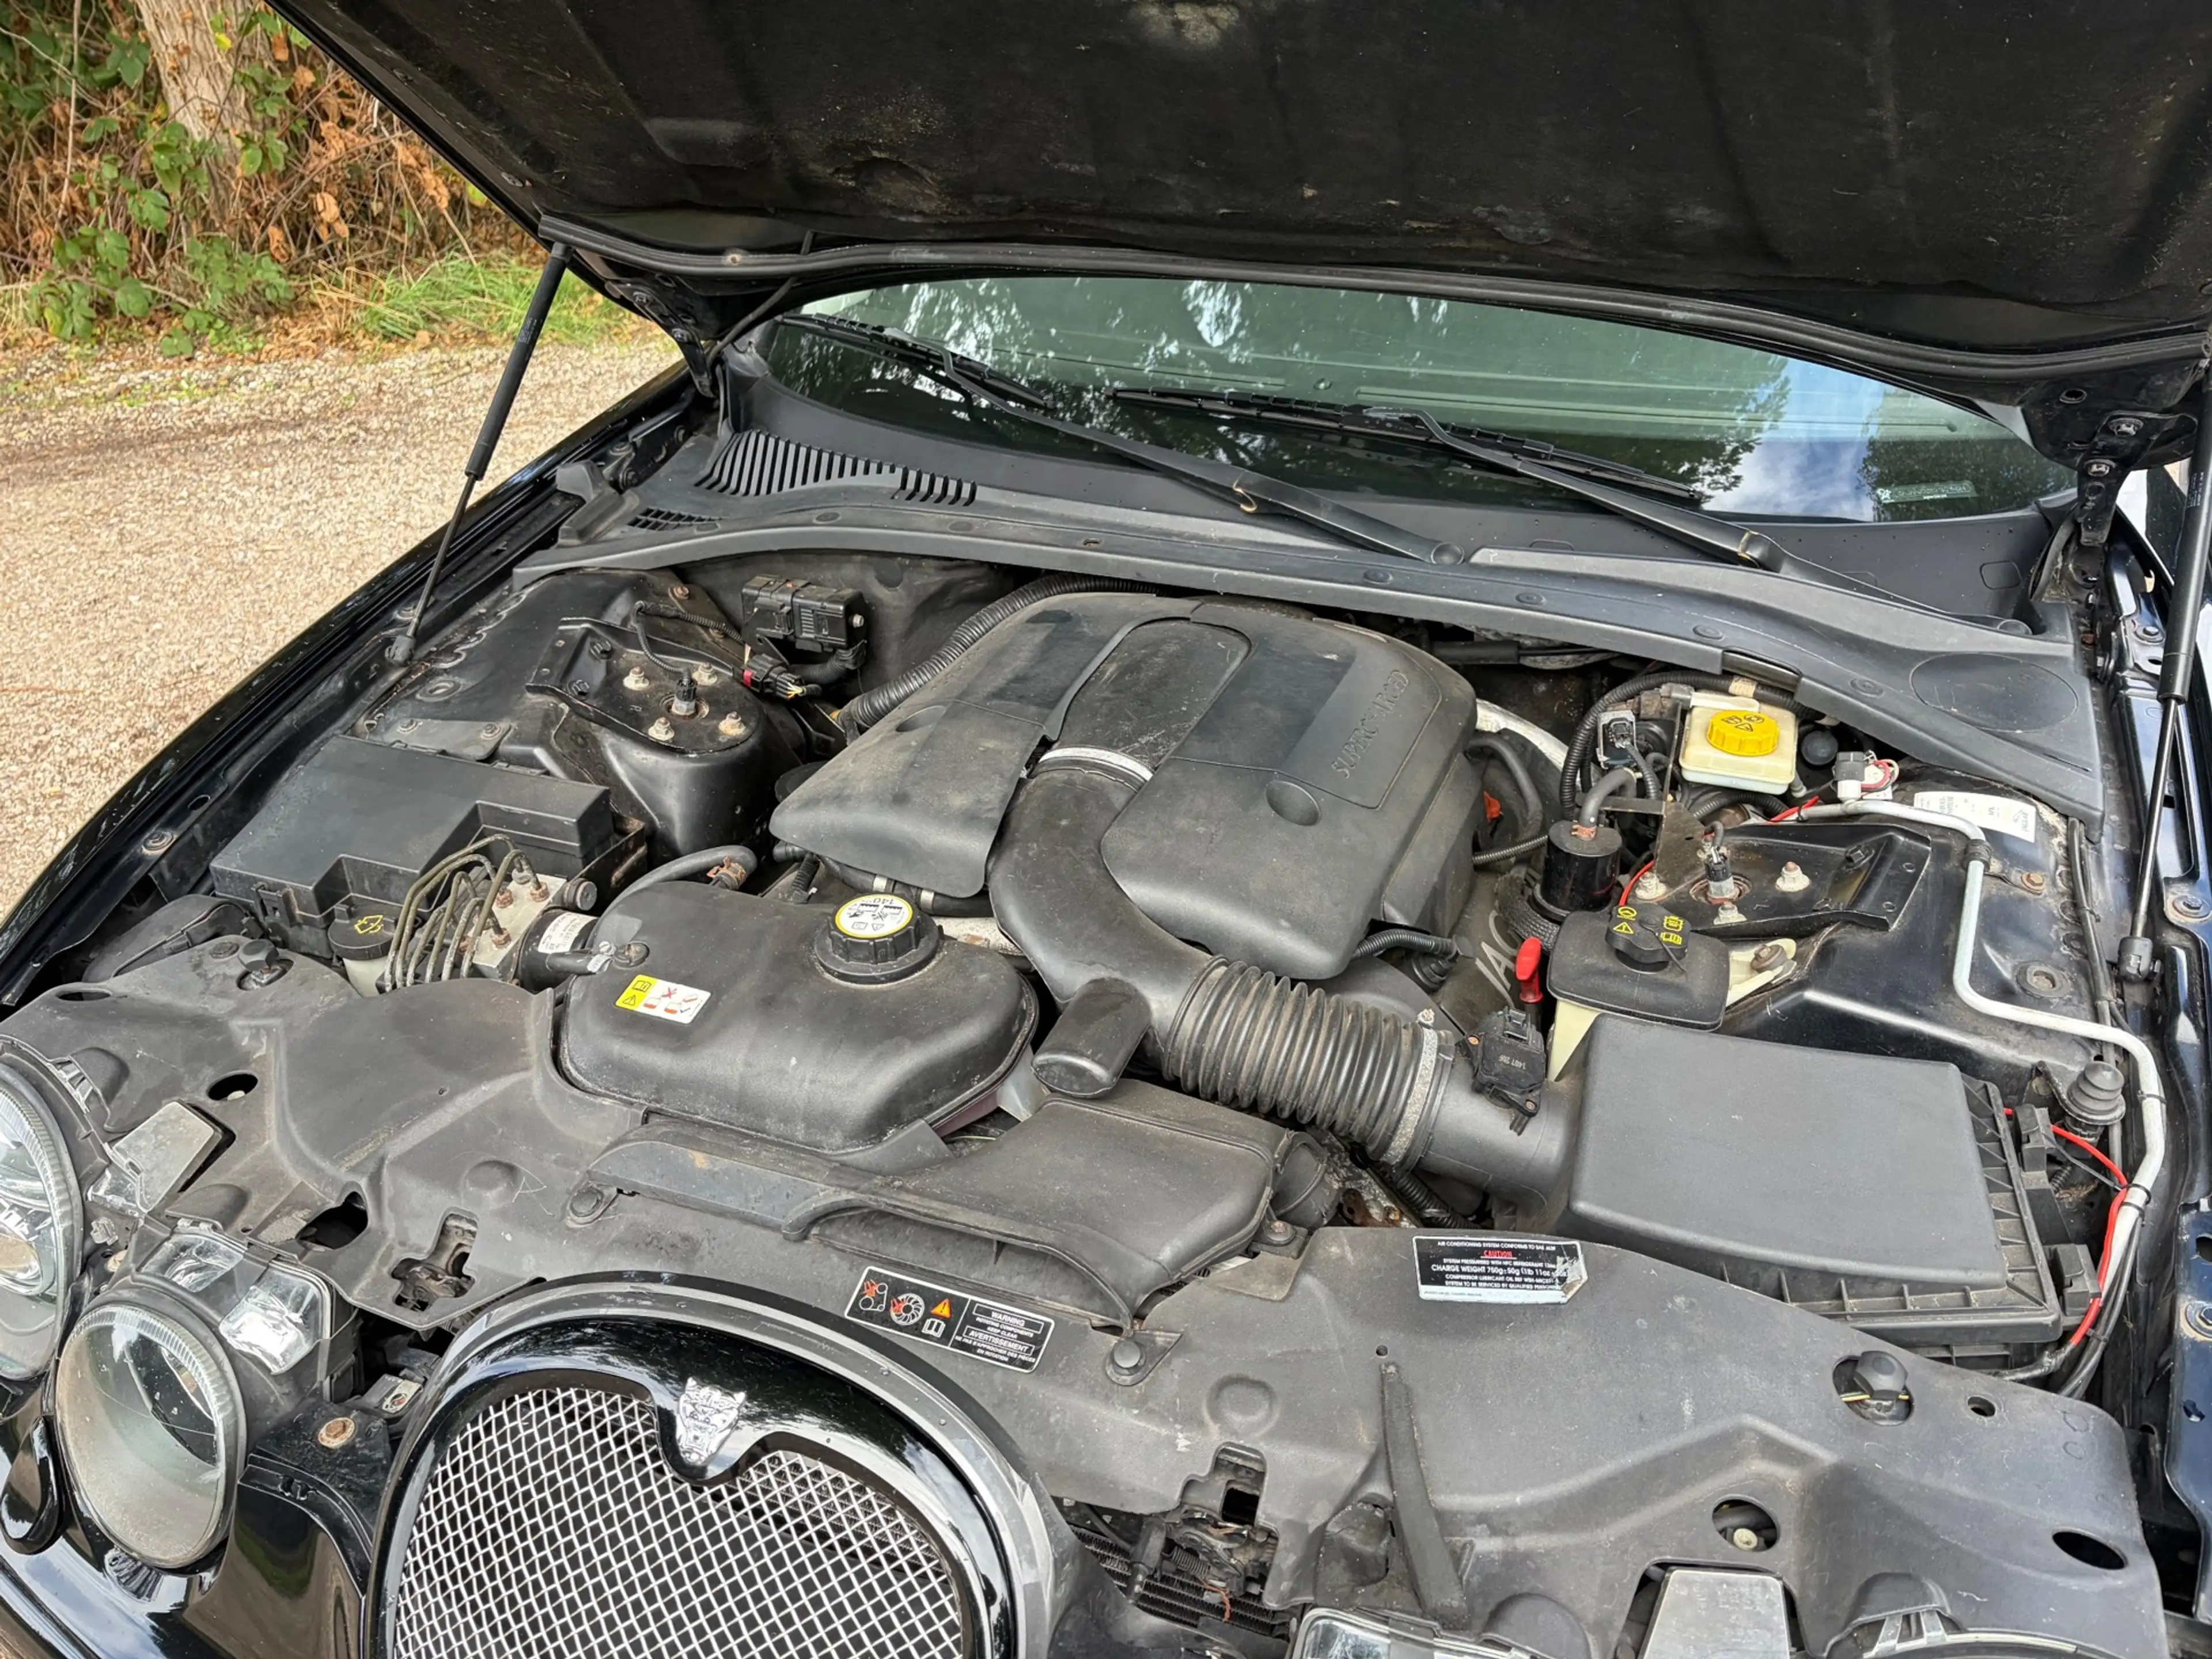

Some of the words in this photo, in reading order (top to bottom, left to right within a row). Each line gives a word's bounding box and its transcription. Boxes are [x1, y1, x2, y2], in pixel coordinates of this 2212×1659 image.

[1331, 670, 1409, 779] SUPERCHARGED
[1431, 1264, 1460, 1272] CHARGE
[991, 1311, 1025, 1327] WARNING
[1000, 1324, 1034, 1338] COMPONENTS
[1001, 1331, 1018, 1339] CLEAR
[969, 1330, 1029, 1353] AVERTISSEMENT
